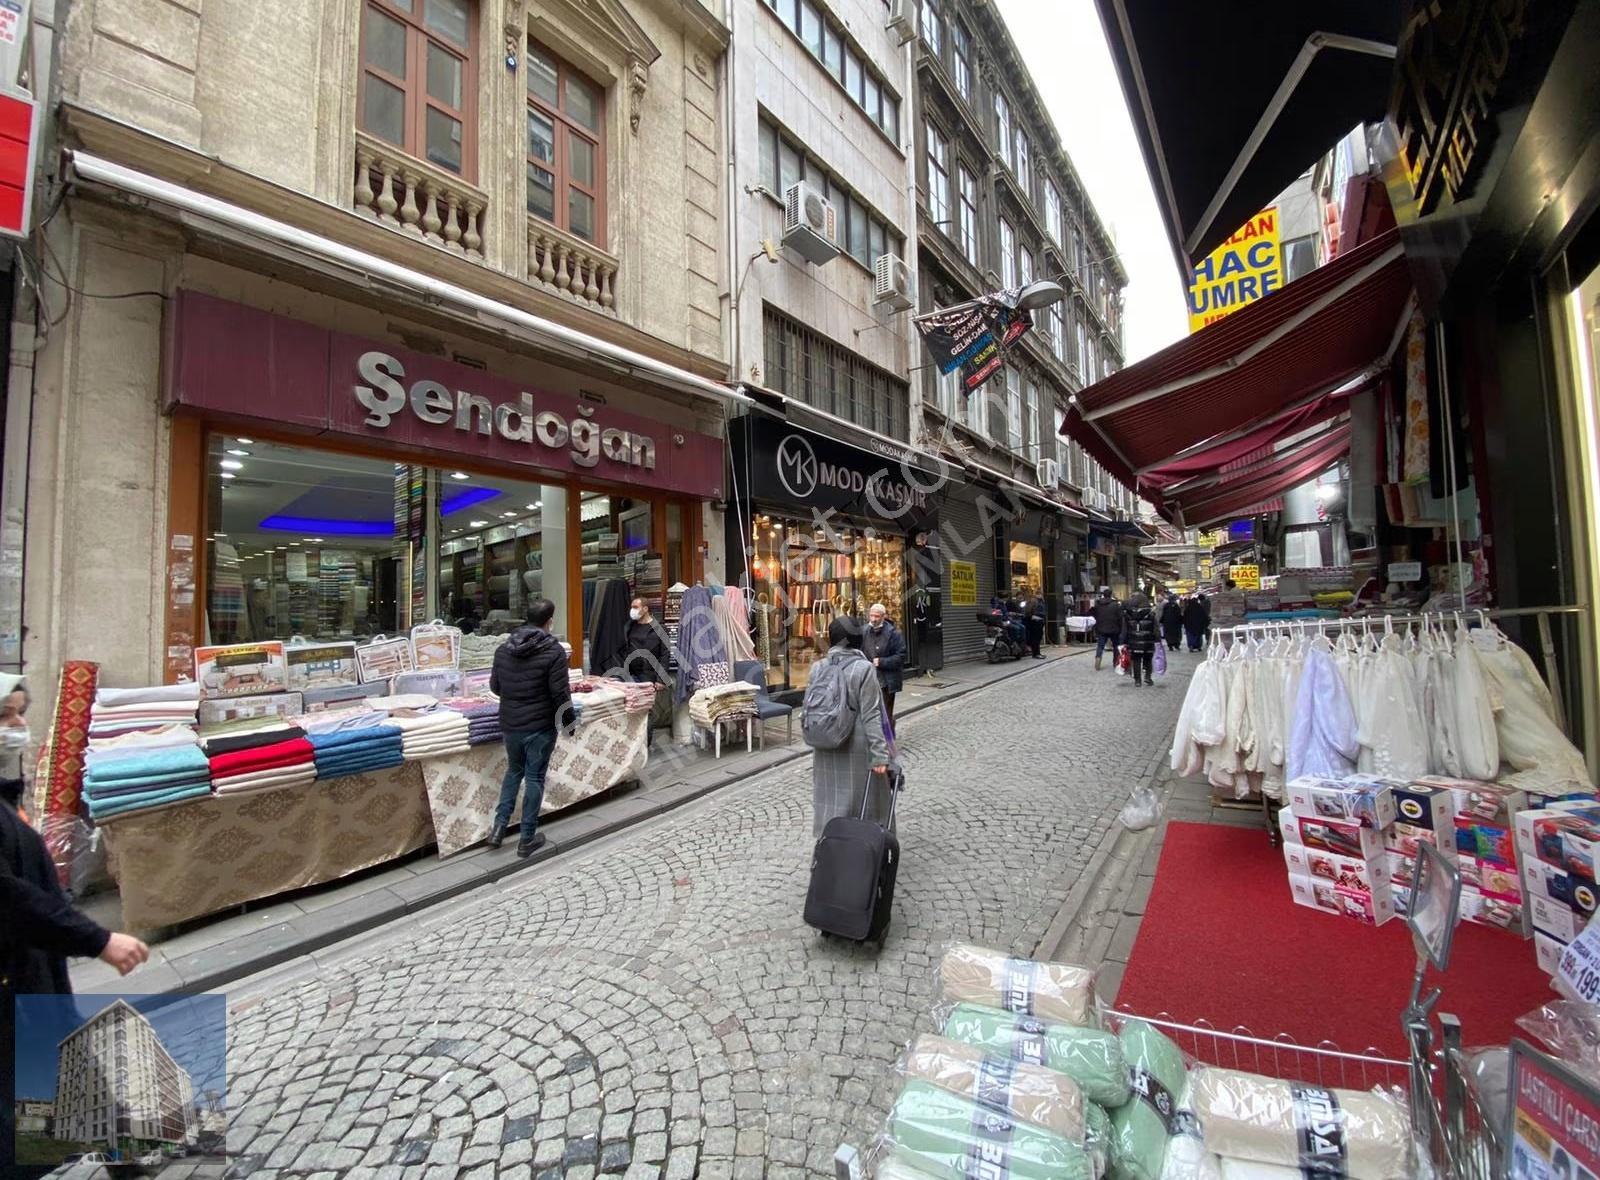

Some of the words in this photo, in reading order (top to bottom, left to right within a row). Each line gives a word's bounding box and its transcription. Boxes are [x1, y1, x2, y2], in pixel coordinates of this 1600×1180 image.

[1190, 241, 1275, 287] HAC
[1189, 269, 1279, 314] UMRE
[355, 351, 656, 469] Şendoğan
[1231, 570, 1258, 579] HAC
